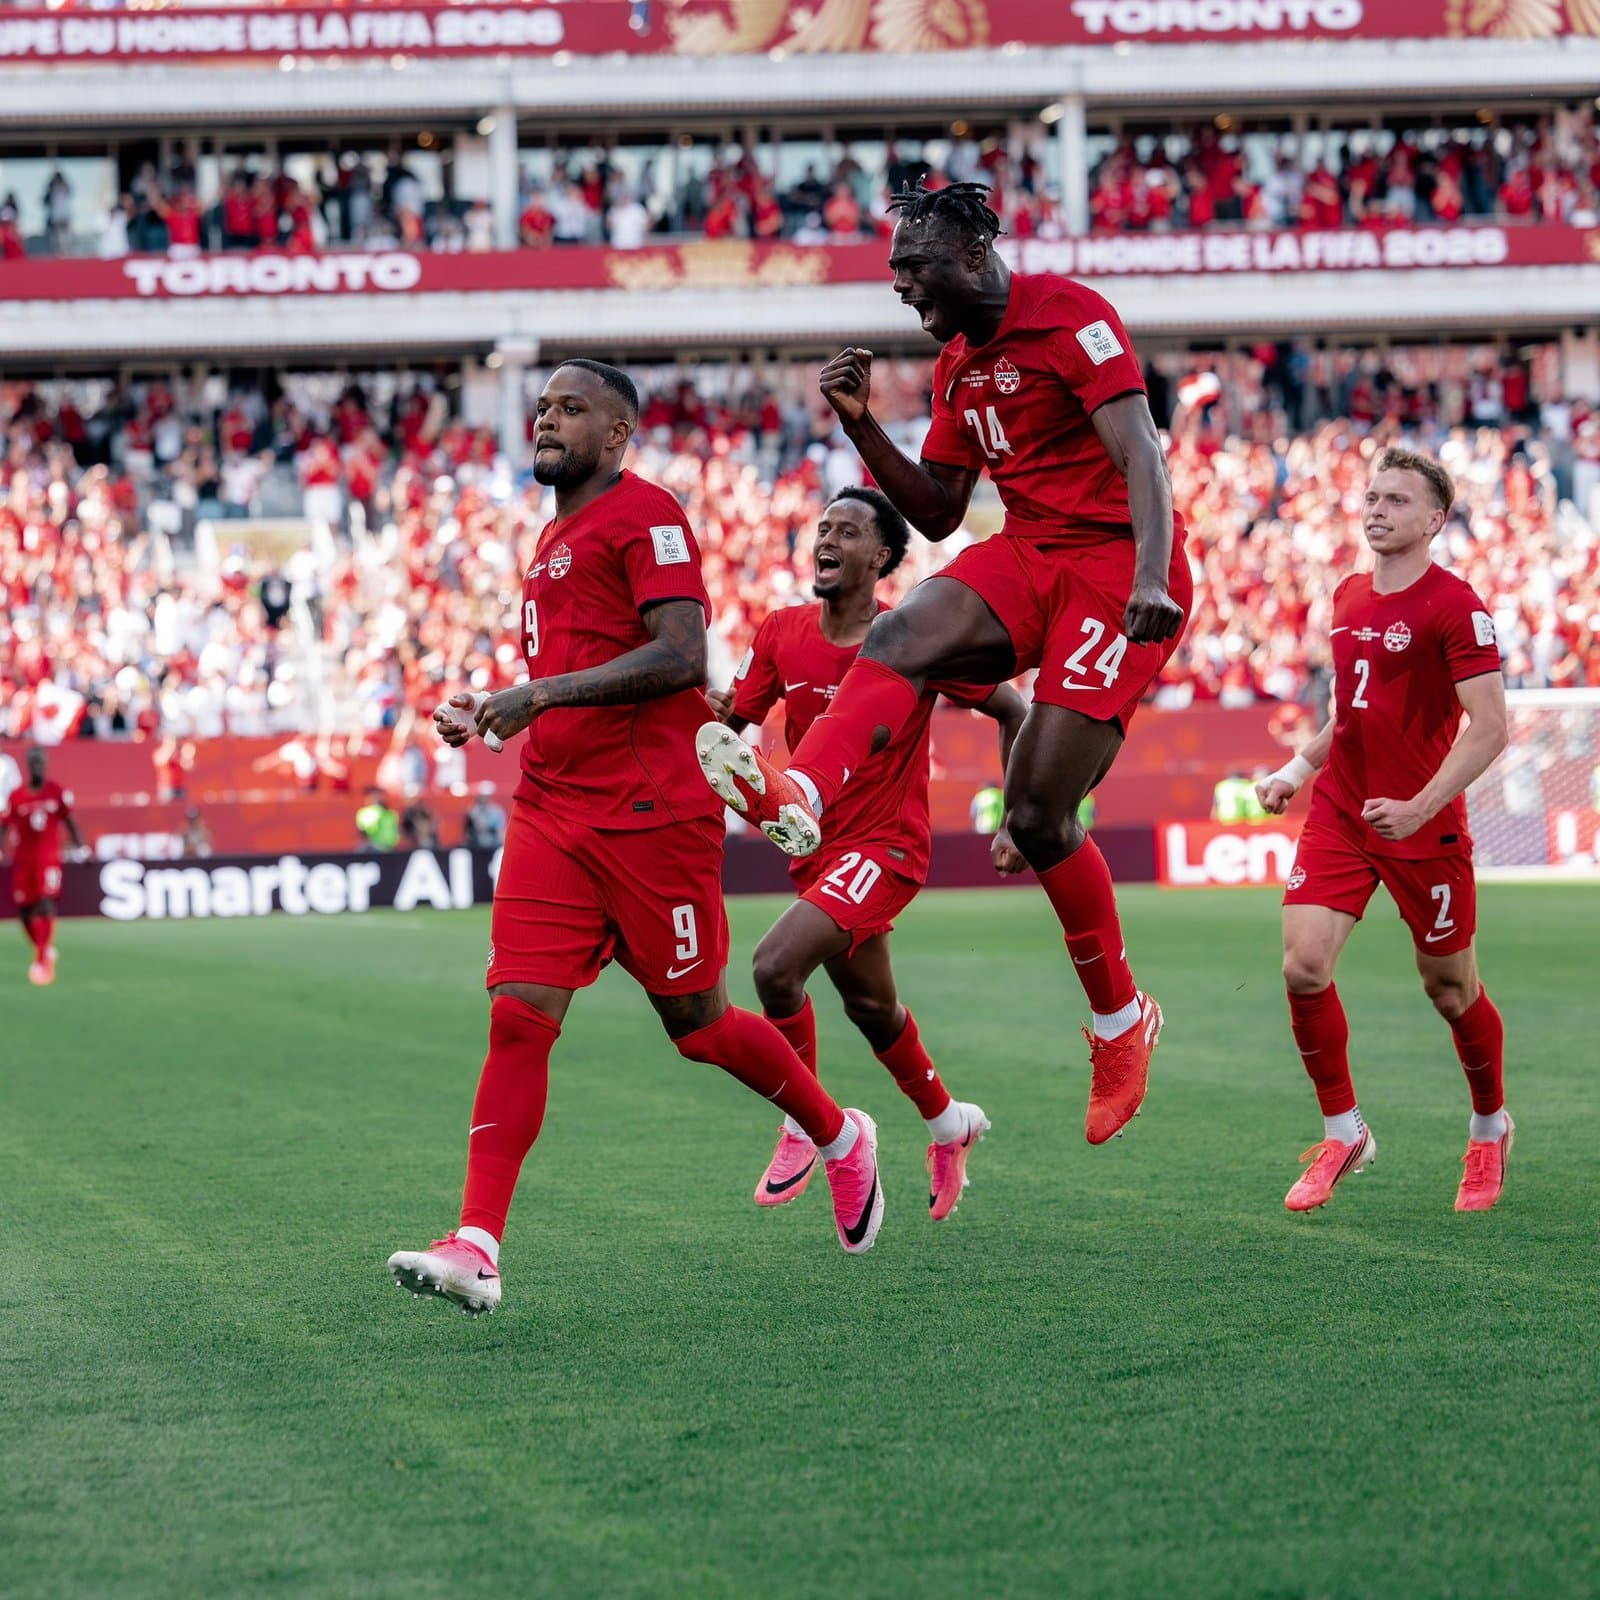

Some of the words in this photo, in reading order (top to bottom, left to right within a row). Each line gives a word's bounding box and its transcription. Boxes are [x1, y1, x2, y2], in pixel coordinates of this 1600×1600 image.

[62, 17, 115, 54] DU
[118, 15, 247, 53] MONDE
[249, 13, 297, 50] DE
[300, 12, 349, 49] LA
[350, 11, 433, 48] FIFA
[433, 9, 564, 46] 2026
[1070, 0, 1363, 33] TORONTO
[123, 252, 421, 295] TORONTO
[1022, 238, 1075, 275] DU
[1077, 234, 1200, 274] MONDE
[1203, 233, 1250, 272] DE
[1252, 231, 1300, 270] LA
[1301, 230, 1381, 269] FIFA
[1382, 228, 1508, 266] 2026
[995, 372, 1018, 380] CANADA
[963, 406, 1015, 459] 24
[525, 599, 540, 657] 9
[1064, 617, 1128, 688] 24
[1351, 659, 1370, 709] 2
[824, 852, 882, 904] 20
[1166, 823, 1300, 884] Len
[100, 855, 382, 920] Smarter
[393, 848, 474, 910] AI
[1431, 883, 1454, 930] 2
[672, 904, 698, 960] 9
